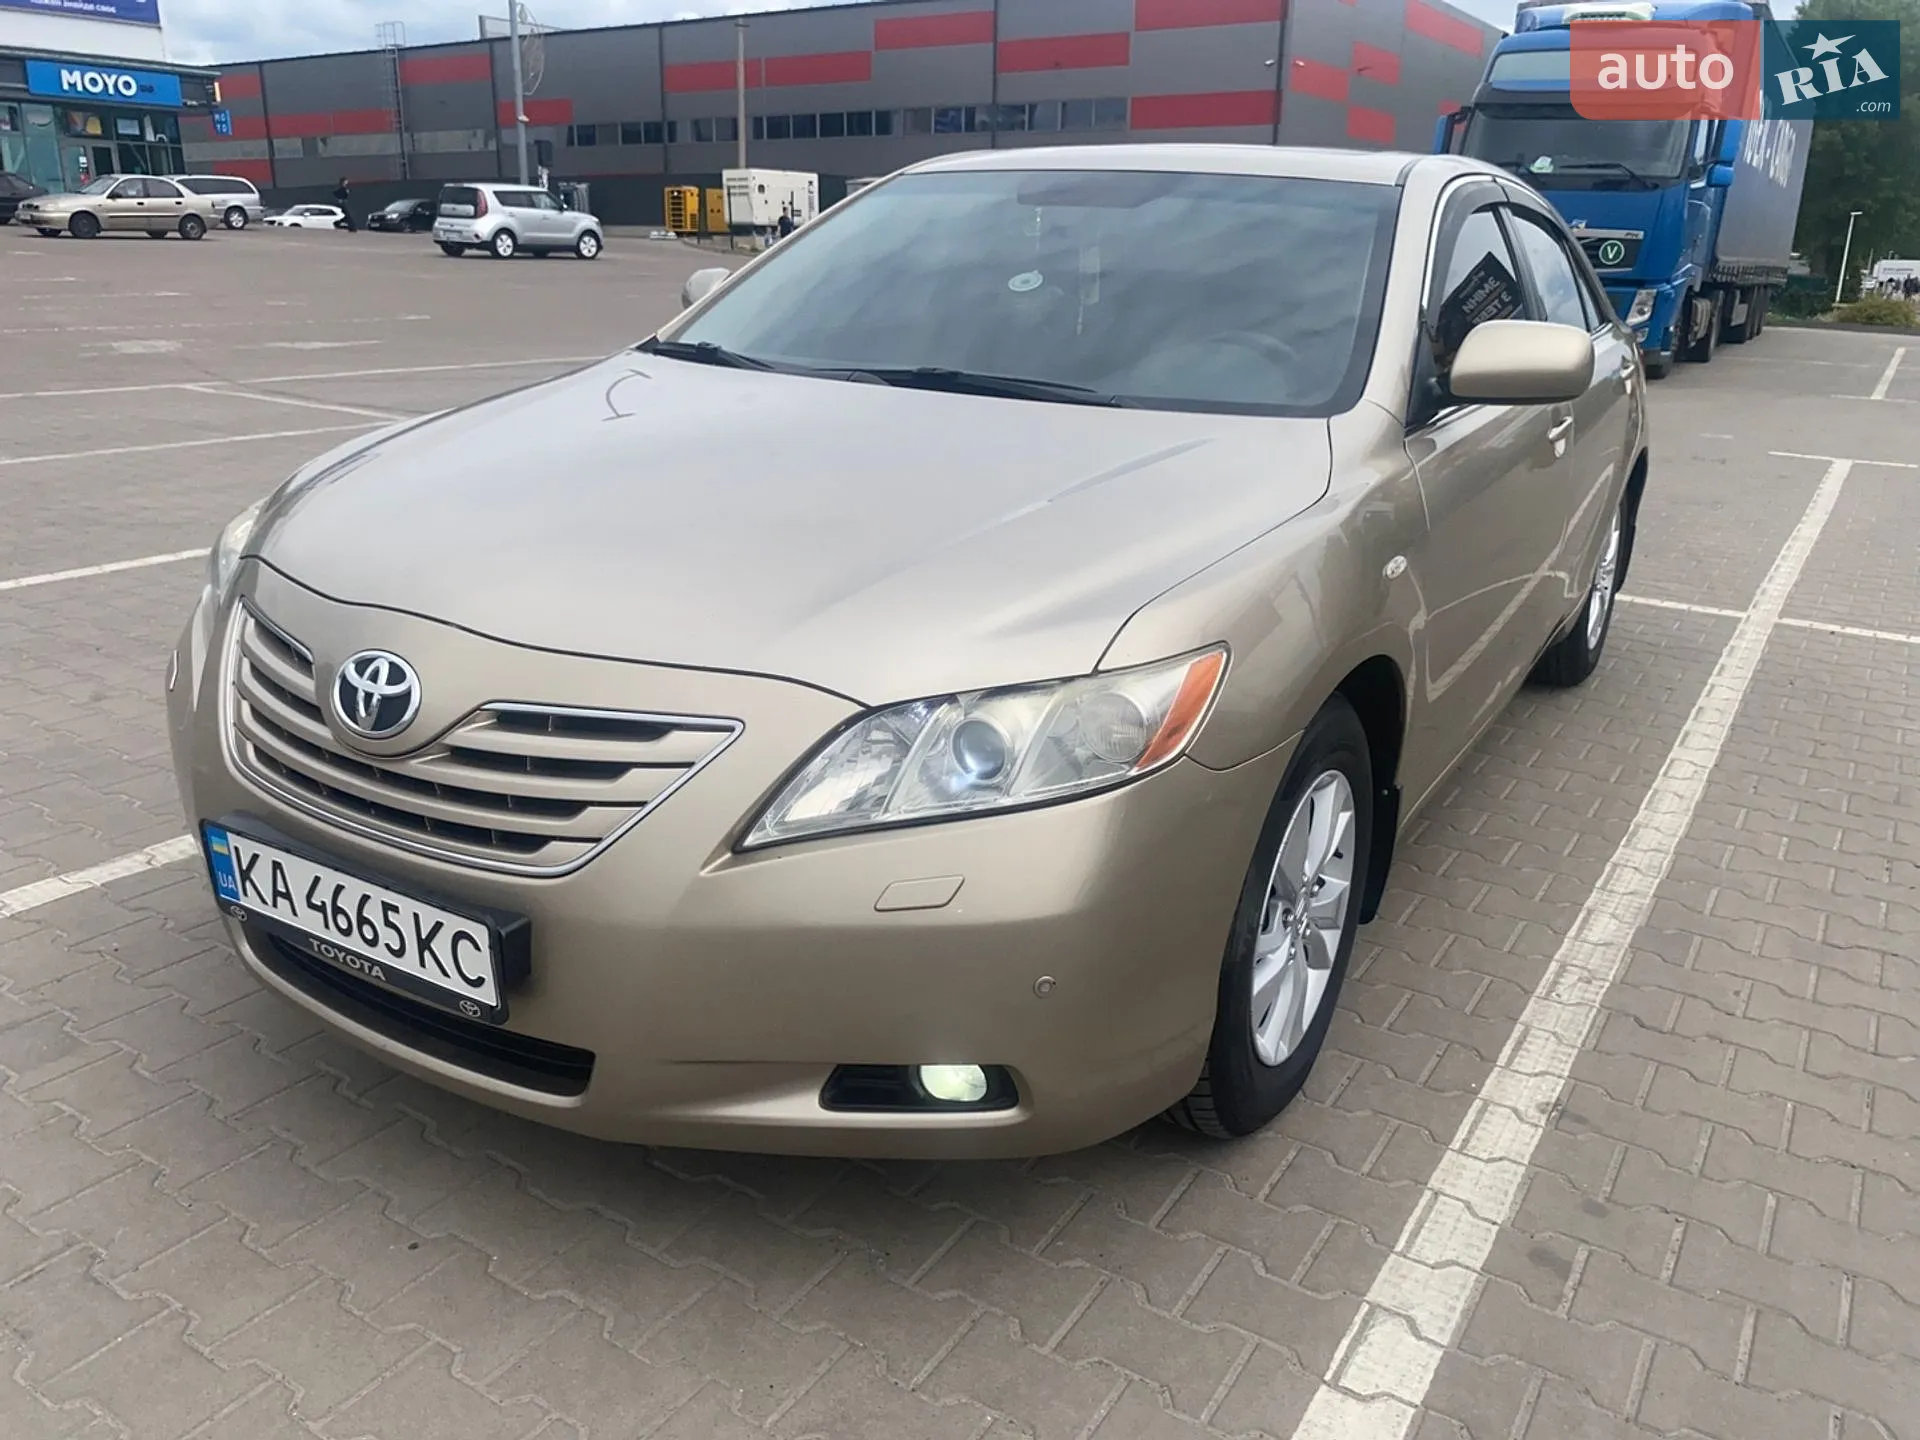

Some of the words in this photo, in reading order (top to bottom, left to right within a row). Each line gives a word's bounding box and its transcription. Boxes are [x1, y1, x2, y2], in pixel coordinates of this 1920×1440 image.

[60, 68, 138, 97] MOYO
[218, 871, 238, 892] UA
[233, 845, 298, 917] KA
[305, 875, 406, 959] 4665
[413, 912, 486, 989] KC
[309, 938, 386, 982] TOYOTA
